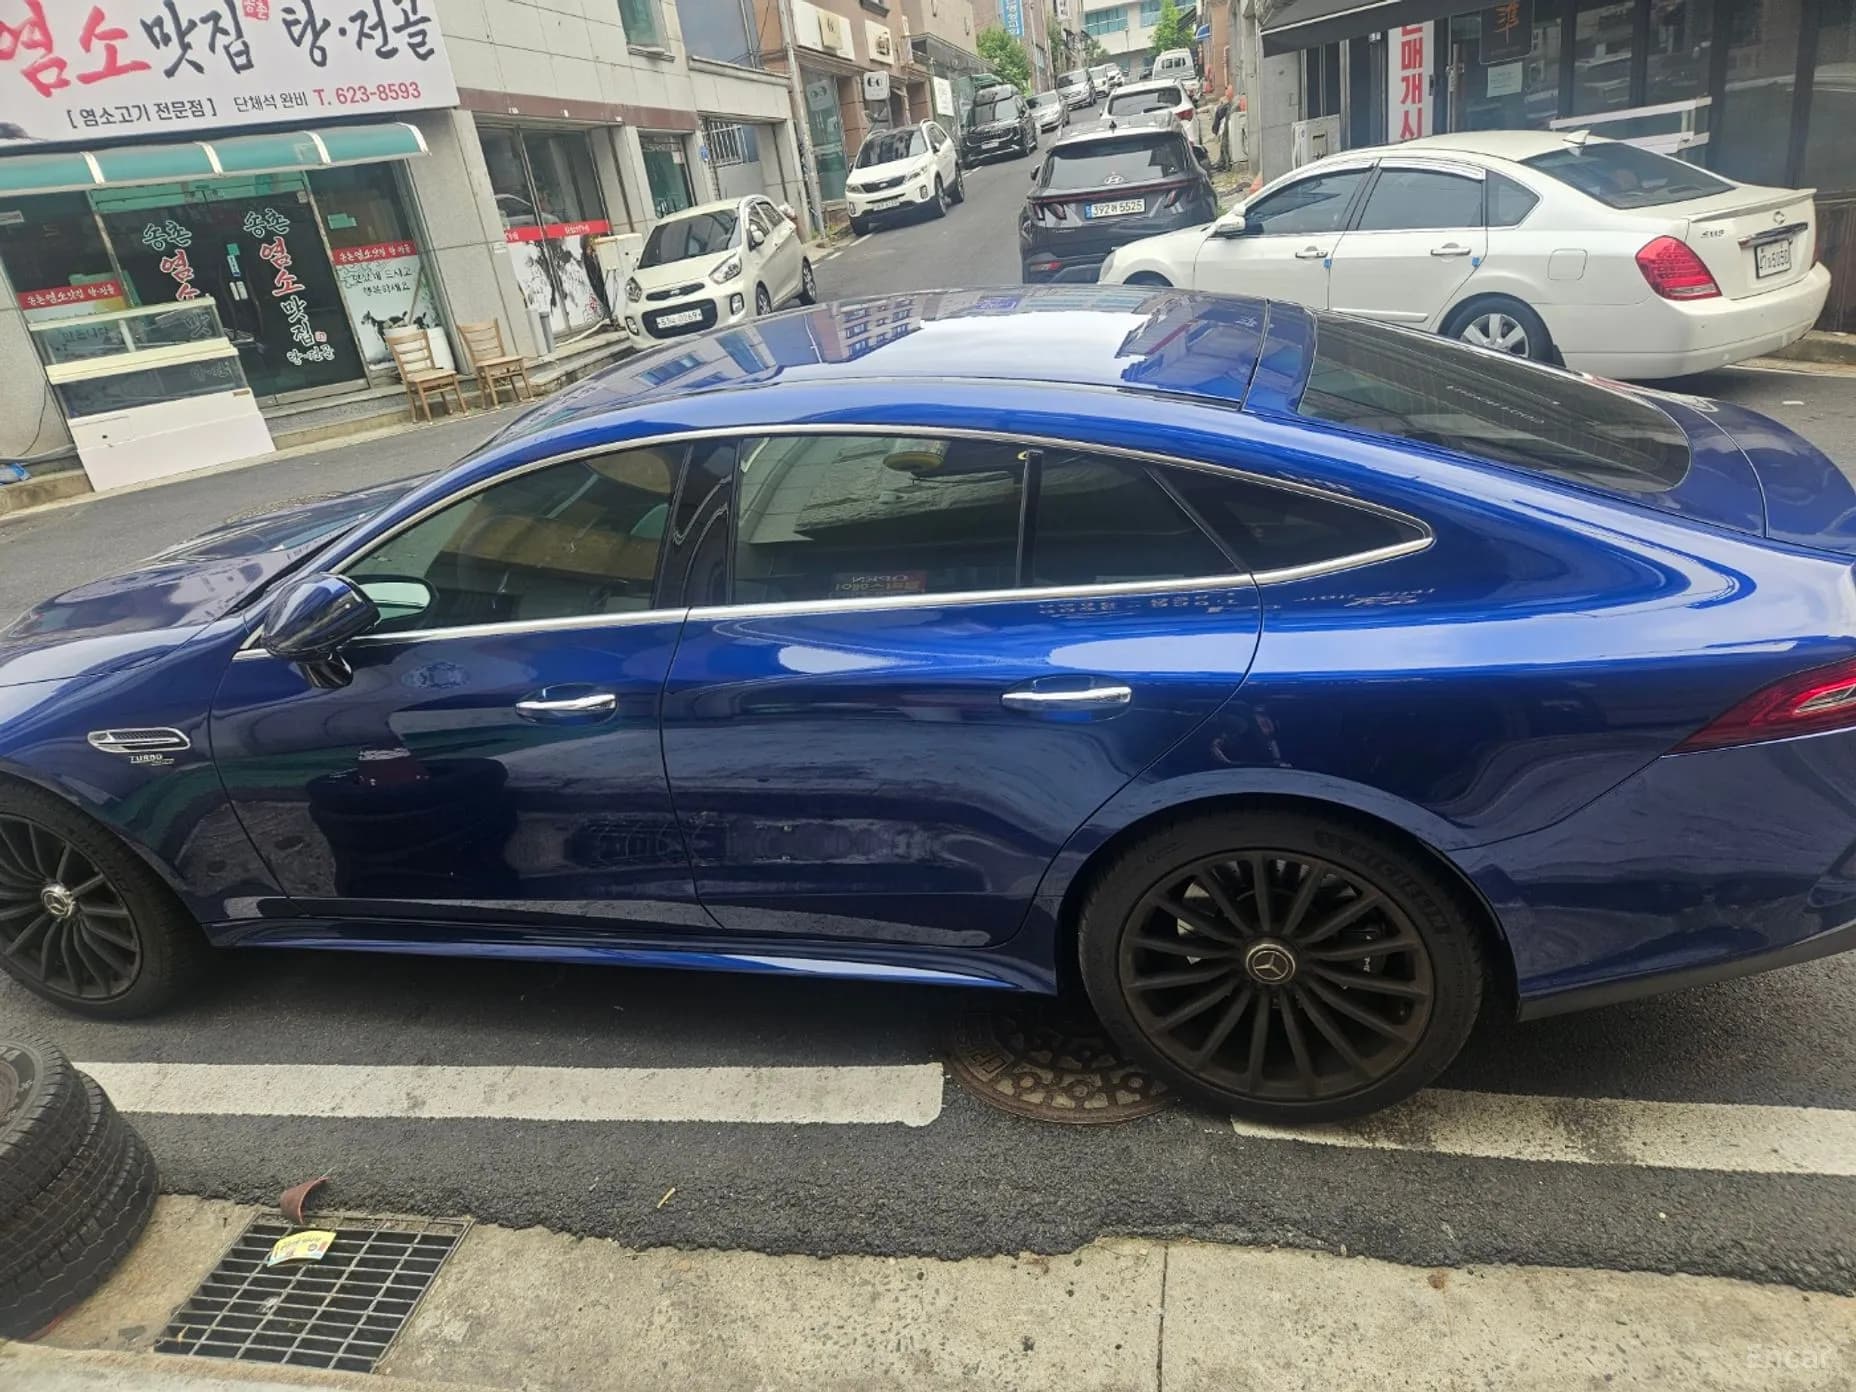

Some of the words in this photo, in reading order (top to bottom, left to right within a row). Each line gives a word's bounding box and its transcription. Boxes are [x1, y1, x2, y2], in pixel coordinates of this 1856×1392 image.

[233, 94, 277, 113] 단체석
[280, 91, 309, 110] 완비
[335, 81, 422, 106] 623-8593
[128, 753, 163, 762] TURBO
